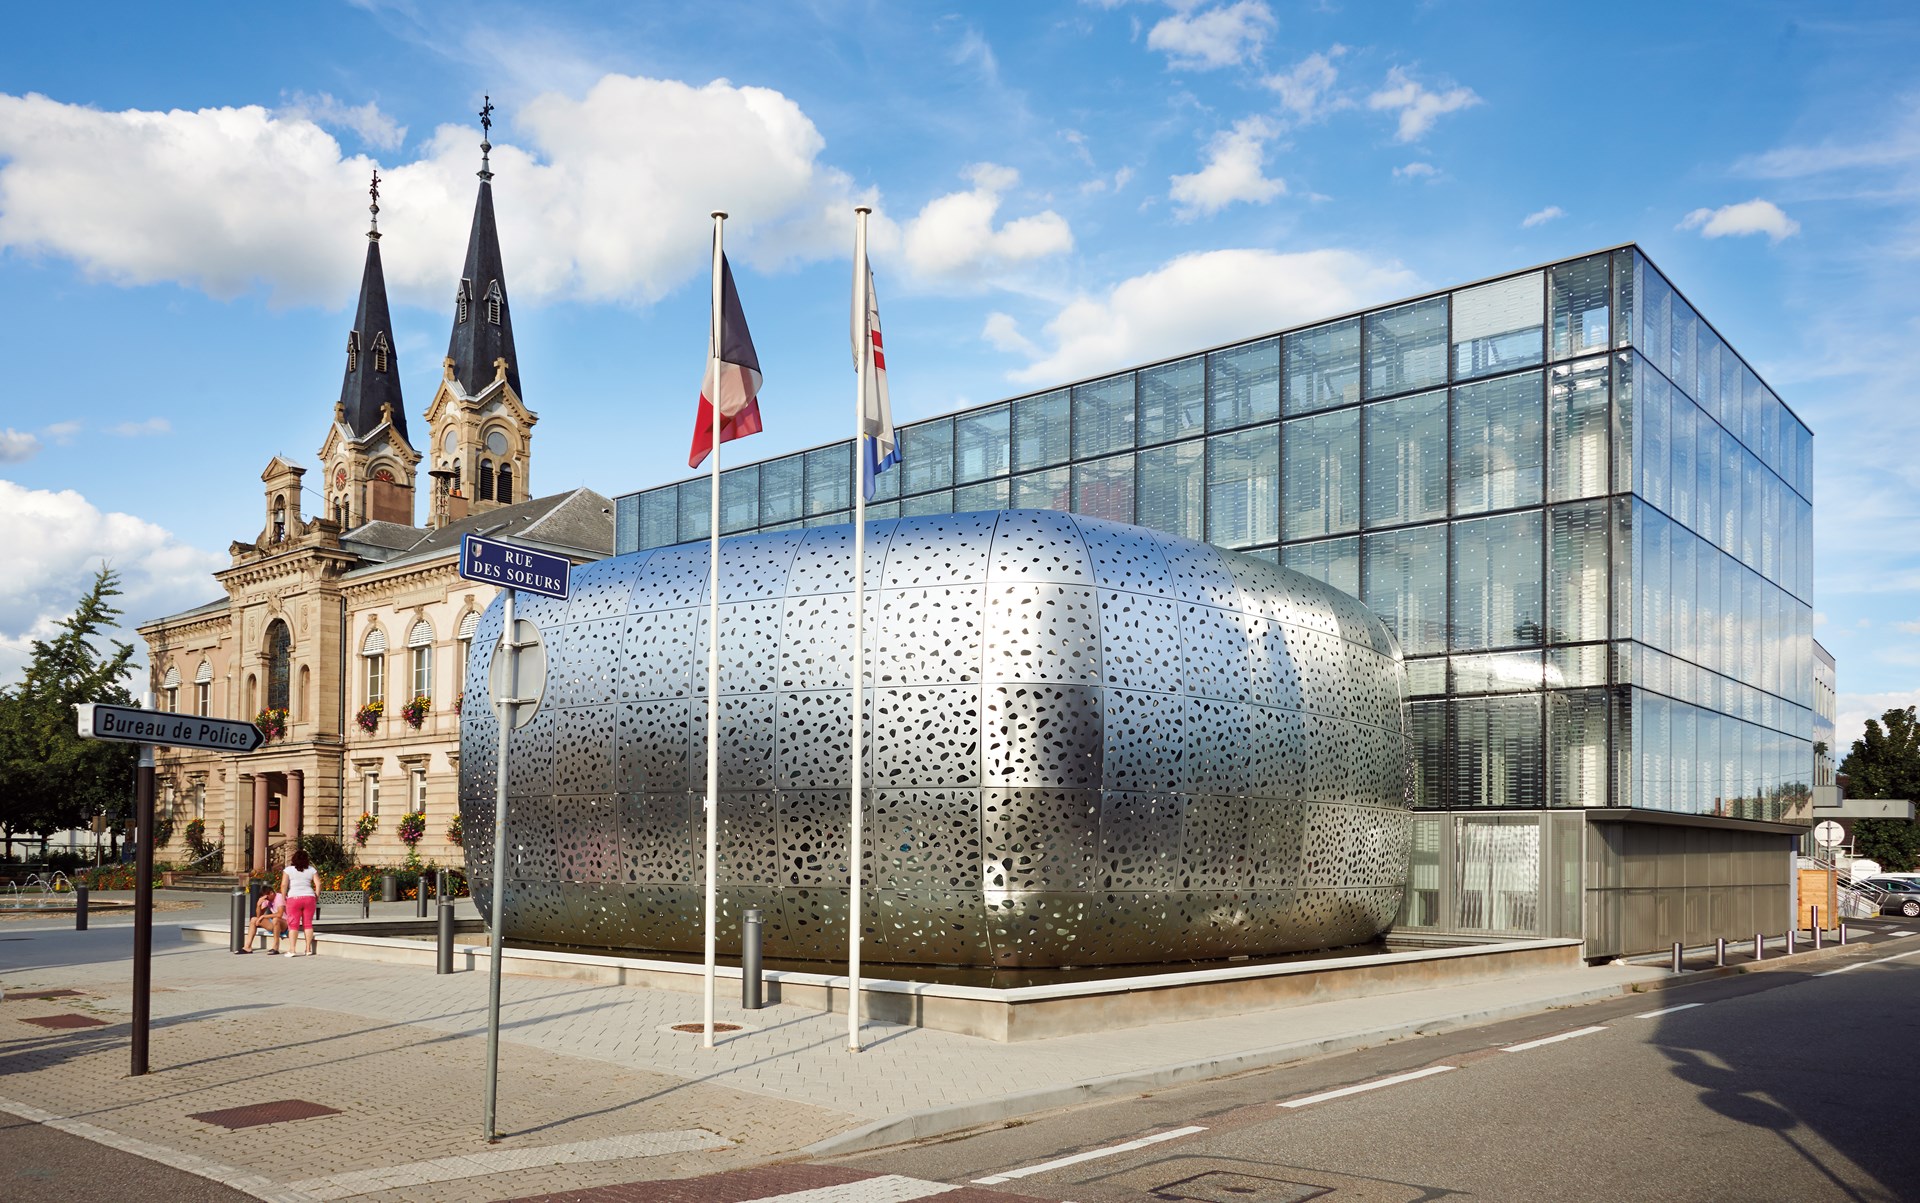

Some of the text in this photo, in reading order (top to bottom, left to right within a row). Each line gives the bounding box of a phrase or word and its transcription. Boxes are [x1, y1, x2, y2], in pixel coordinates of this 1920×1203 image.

[505, 551, 533, 568] RUE
[473, 561, 561, 591] DES SOEURS
[103, 712, 248, 746] Bureau de Police
